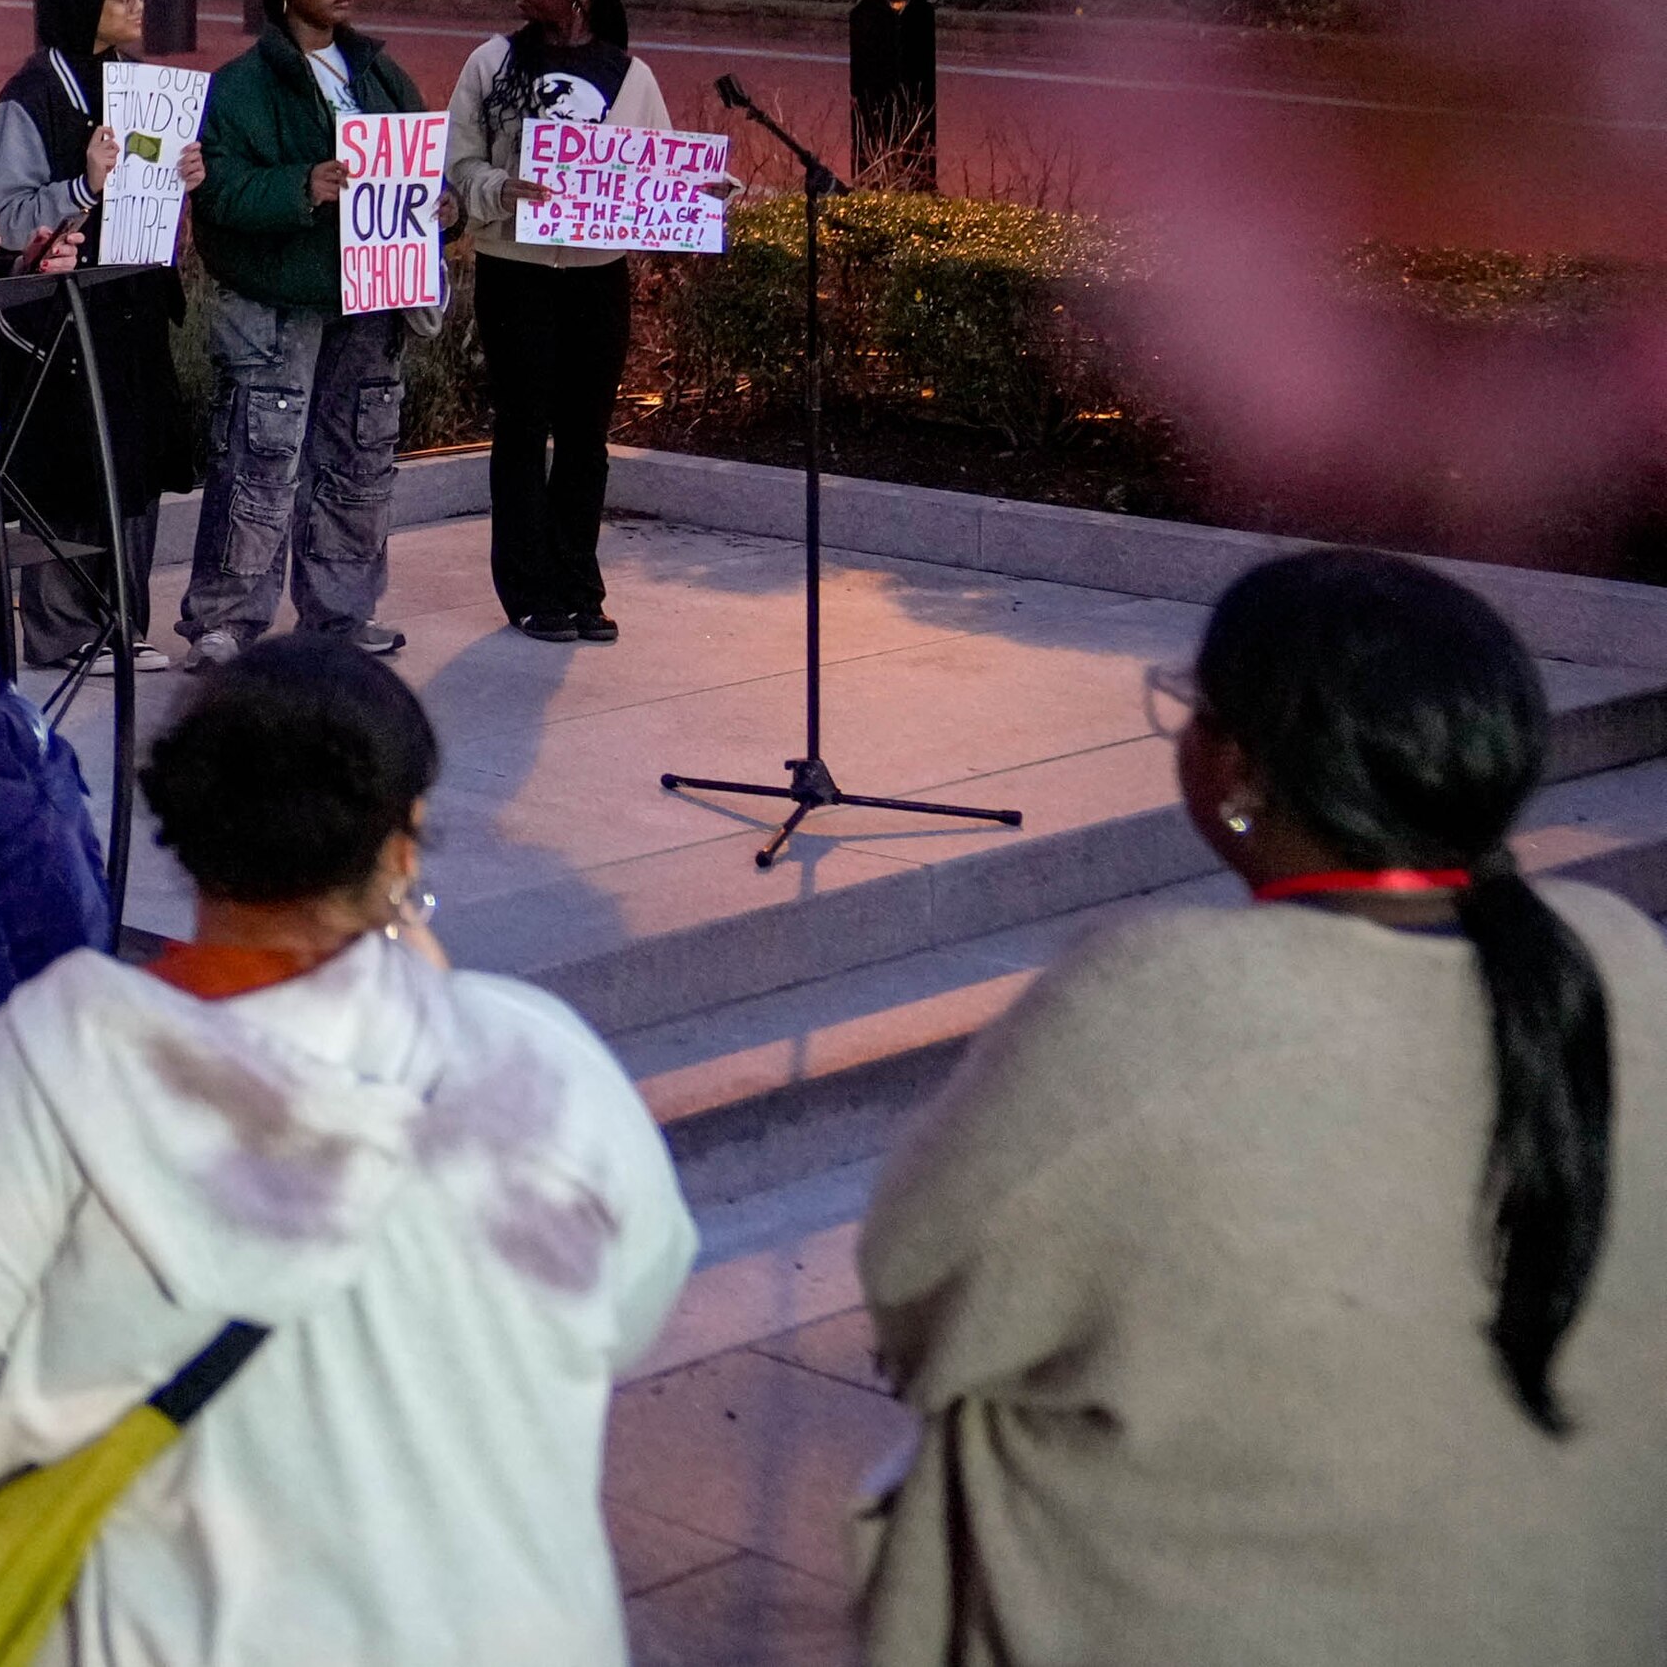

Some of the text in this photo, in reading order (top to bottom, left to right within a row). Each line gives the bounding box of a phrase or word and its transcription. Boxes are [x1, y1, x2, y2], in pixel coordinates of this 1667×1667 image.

[107, 65, 207, 96] CUT OUR
[108, 90, 198, 139] FUNDS
[342, 117, 445, 178] SAVE
[532, 124, 729, 173] EDUCATION
[142, 164, 180, 192] OUR
[532, 167, 701, 203] IS THE CURE
[104, 194, 179, 263] FUTURE
[352, 182, 428, 241] OUR
[528, 201, 564, 220] TO
[572, 202, 622, 223] THE
[537, 221, 705, 246] OF IGNORANCE!
[343, 243, 435, 311] SCHOOL
